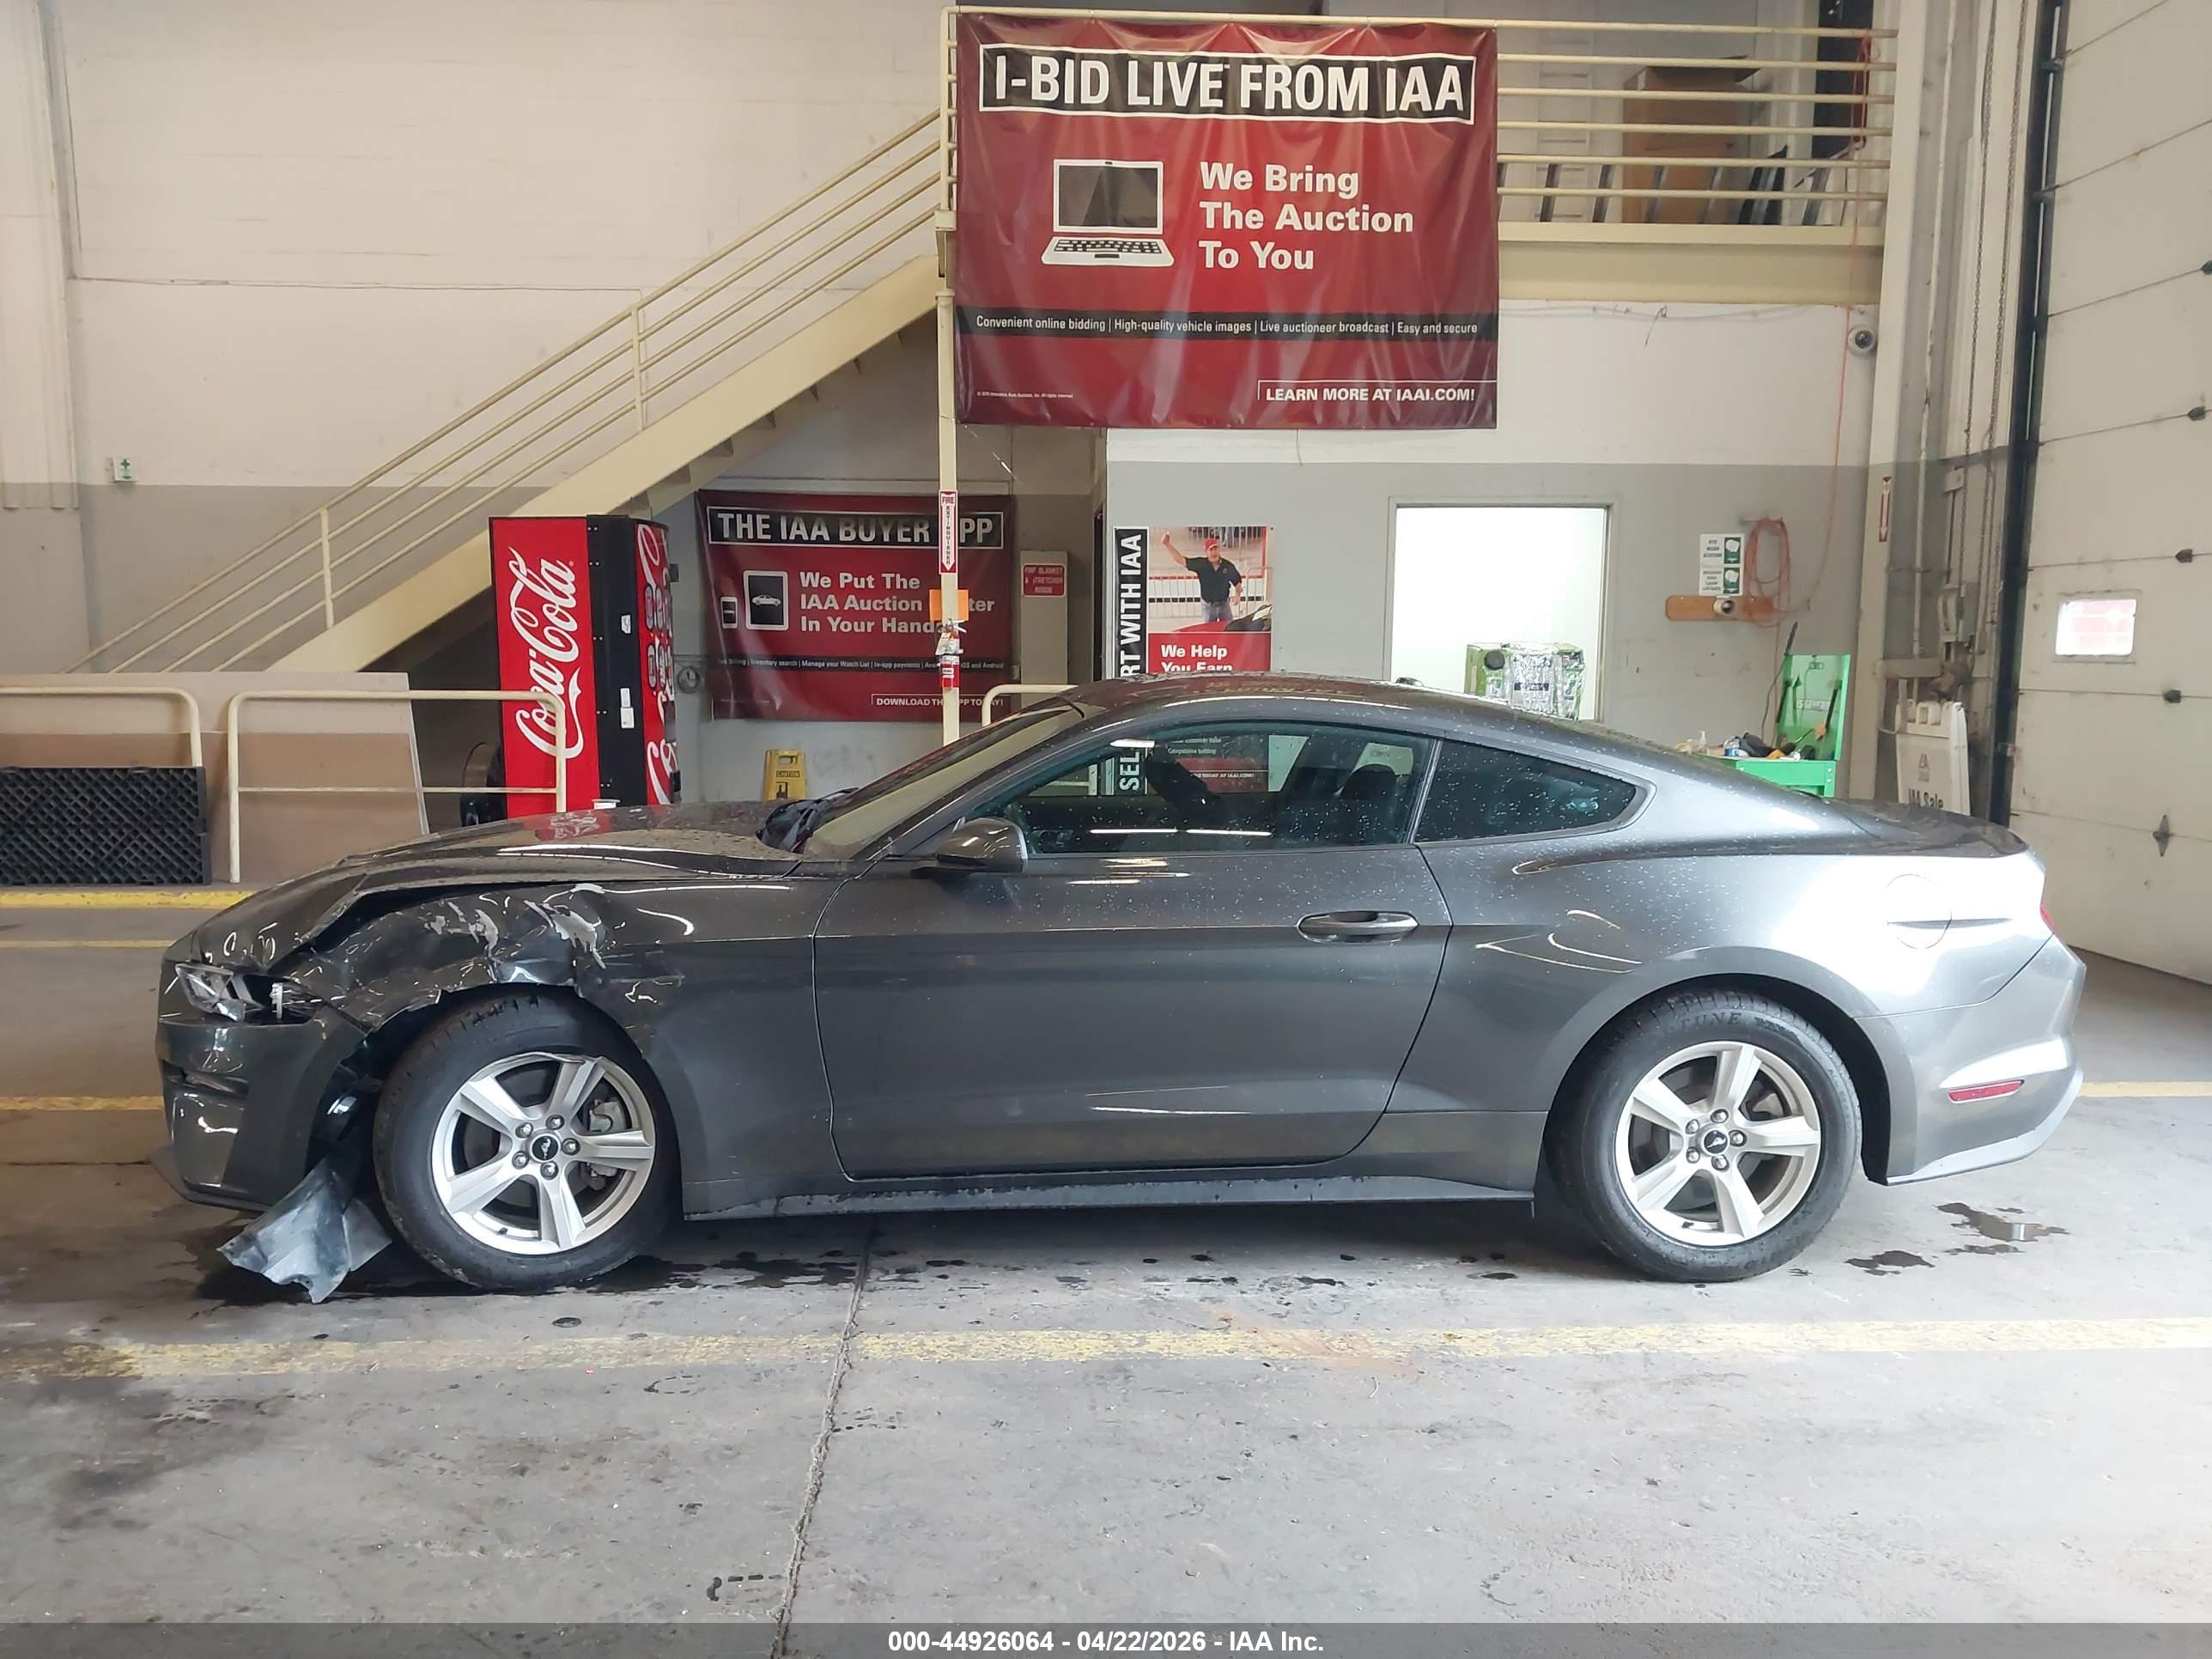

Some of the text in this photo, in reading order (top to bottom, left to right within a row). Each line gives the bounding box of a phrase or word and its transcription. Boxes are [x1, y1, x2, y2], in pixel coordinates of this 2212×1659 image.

[996, 55, 1464, 112] I-BID LIVE FROM IAA
[1200, 161, 1358, 199] We Bring
[1199, 201, 1413, 233] The Auction
[1198, 240, 1314, 270] To You
[976, 314, 1477, 335] Convenient online bidding High-quality vehicle images Live auctioneer broadcast Easy and secure
[1266, 387, 1475, 401] LEARN MORE AT IAAI.COM!
[717, 513, 993, 544] THE IAA BUYER PP
[1120, 534, 1141, 575] IAA
[799, 572, 921, 590] We Put The
[800, 593, 995, 611] IAA Auction ter
[800, 616, 821, 632] In
[827, 616, 875, 632] Your
[1120, 583, 1141, 645] WITH
[1161, 644, 1228, 660] We Help
[801, 659, 825, 668] Manage
[1161, 661, 1233, 672] You Earn
[972, 698, 1004, 707] TOAY!
[1119, 751, 1140, 791] SEL
